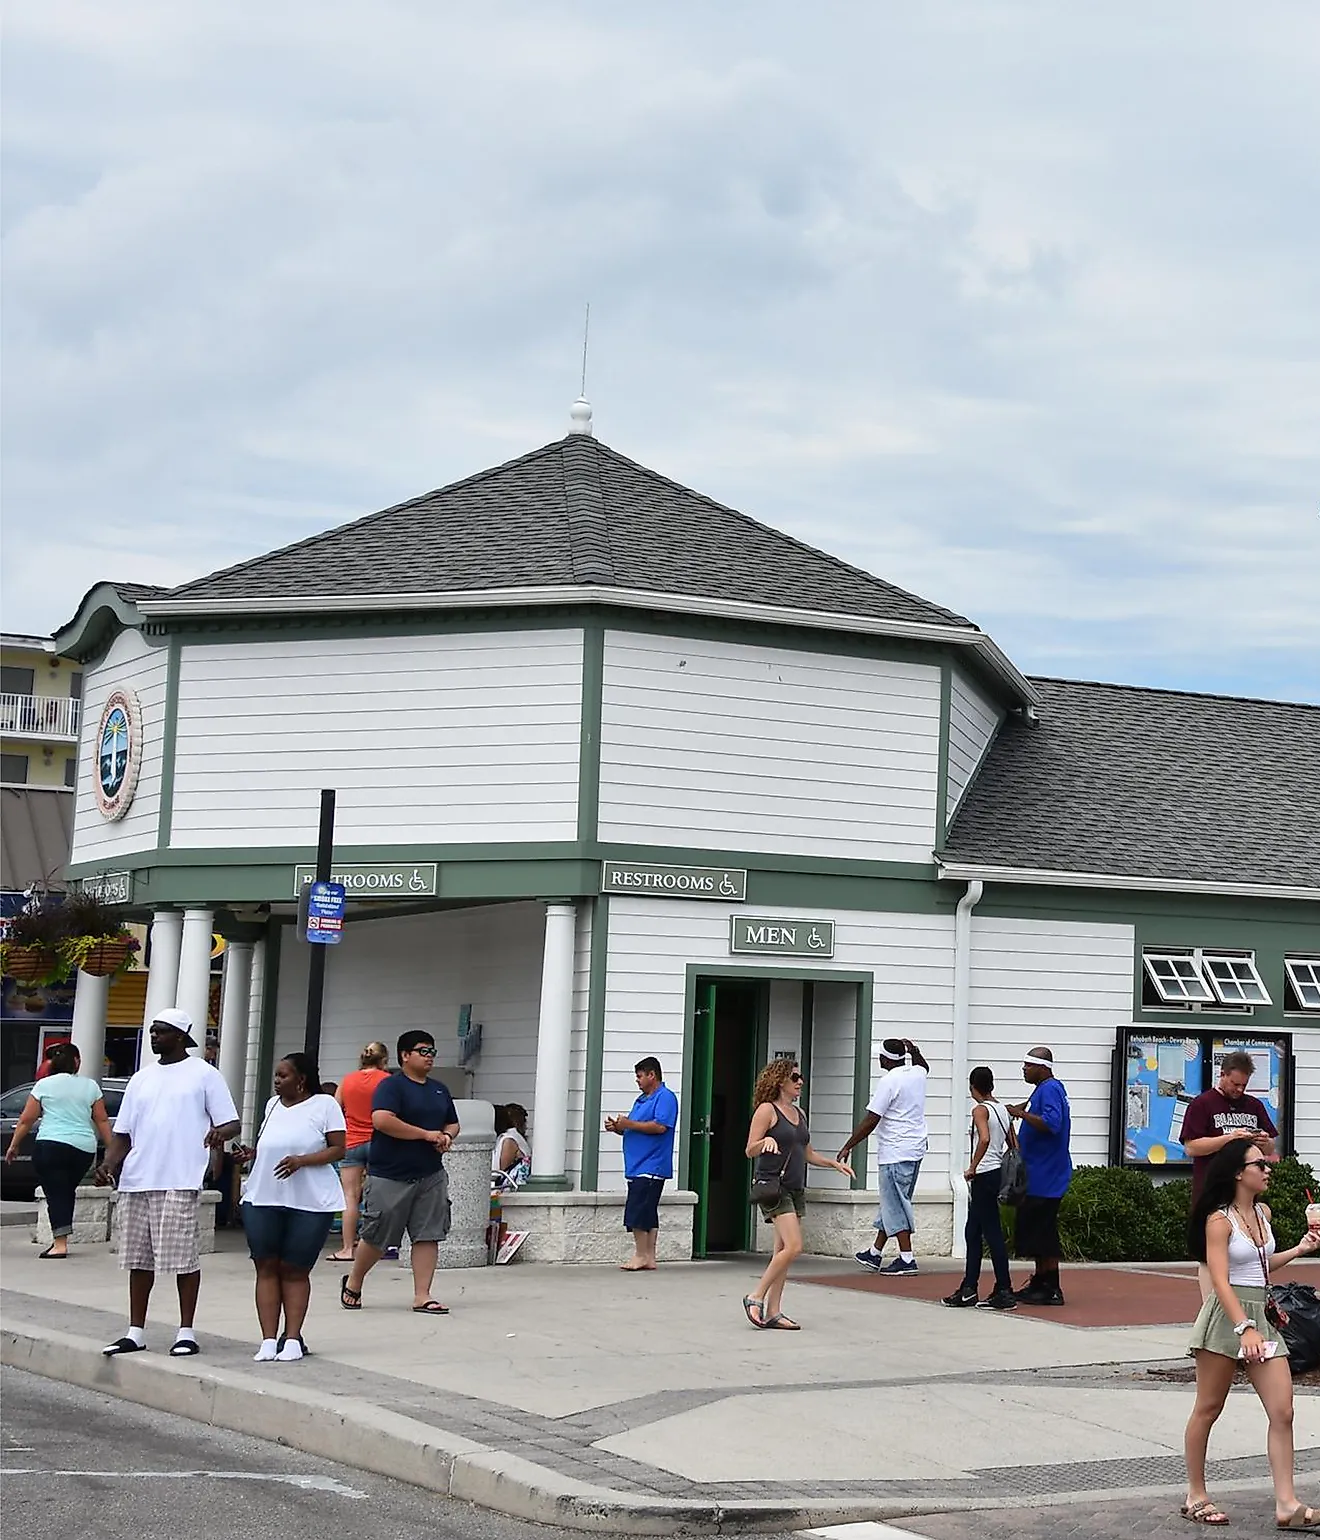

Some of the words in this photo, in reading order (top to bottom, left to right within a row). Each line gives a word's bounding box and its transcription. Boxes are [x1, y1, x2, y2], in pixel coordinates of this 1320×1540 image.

[303, 873, 404, 888] RTROOMS
[611, 871, 714, 891] RESTROOMS
[744, 925, 798, 946] MEN
[1223, 1038, 1245, 1046] Chamber
